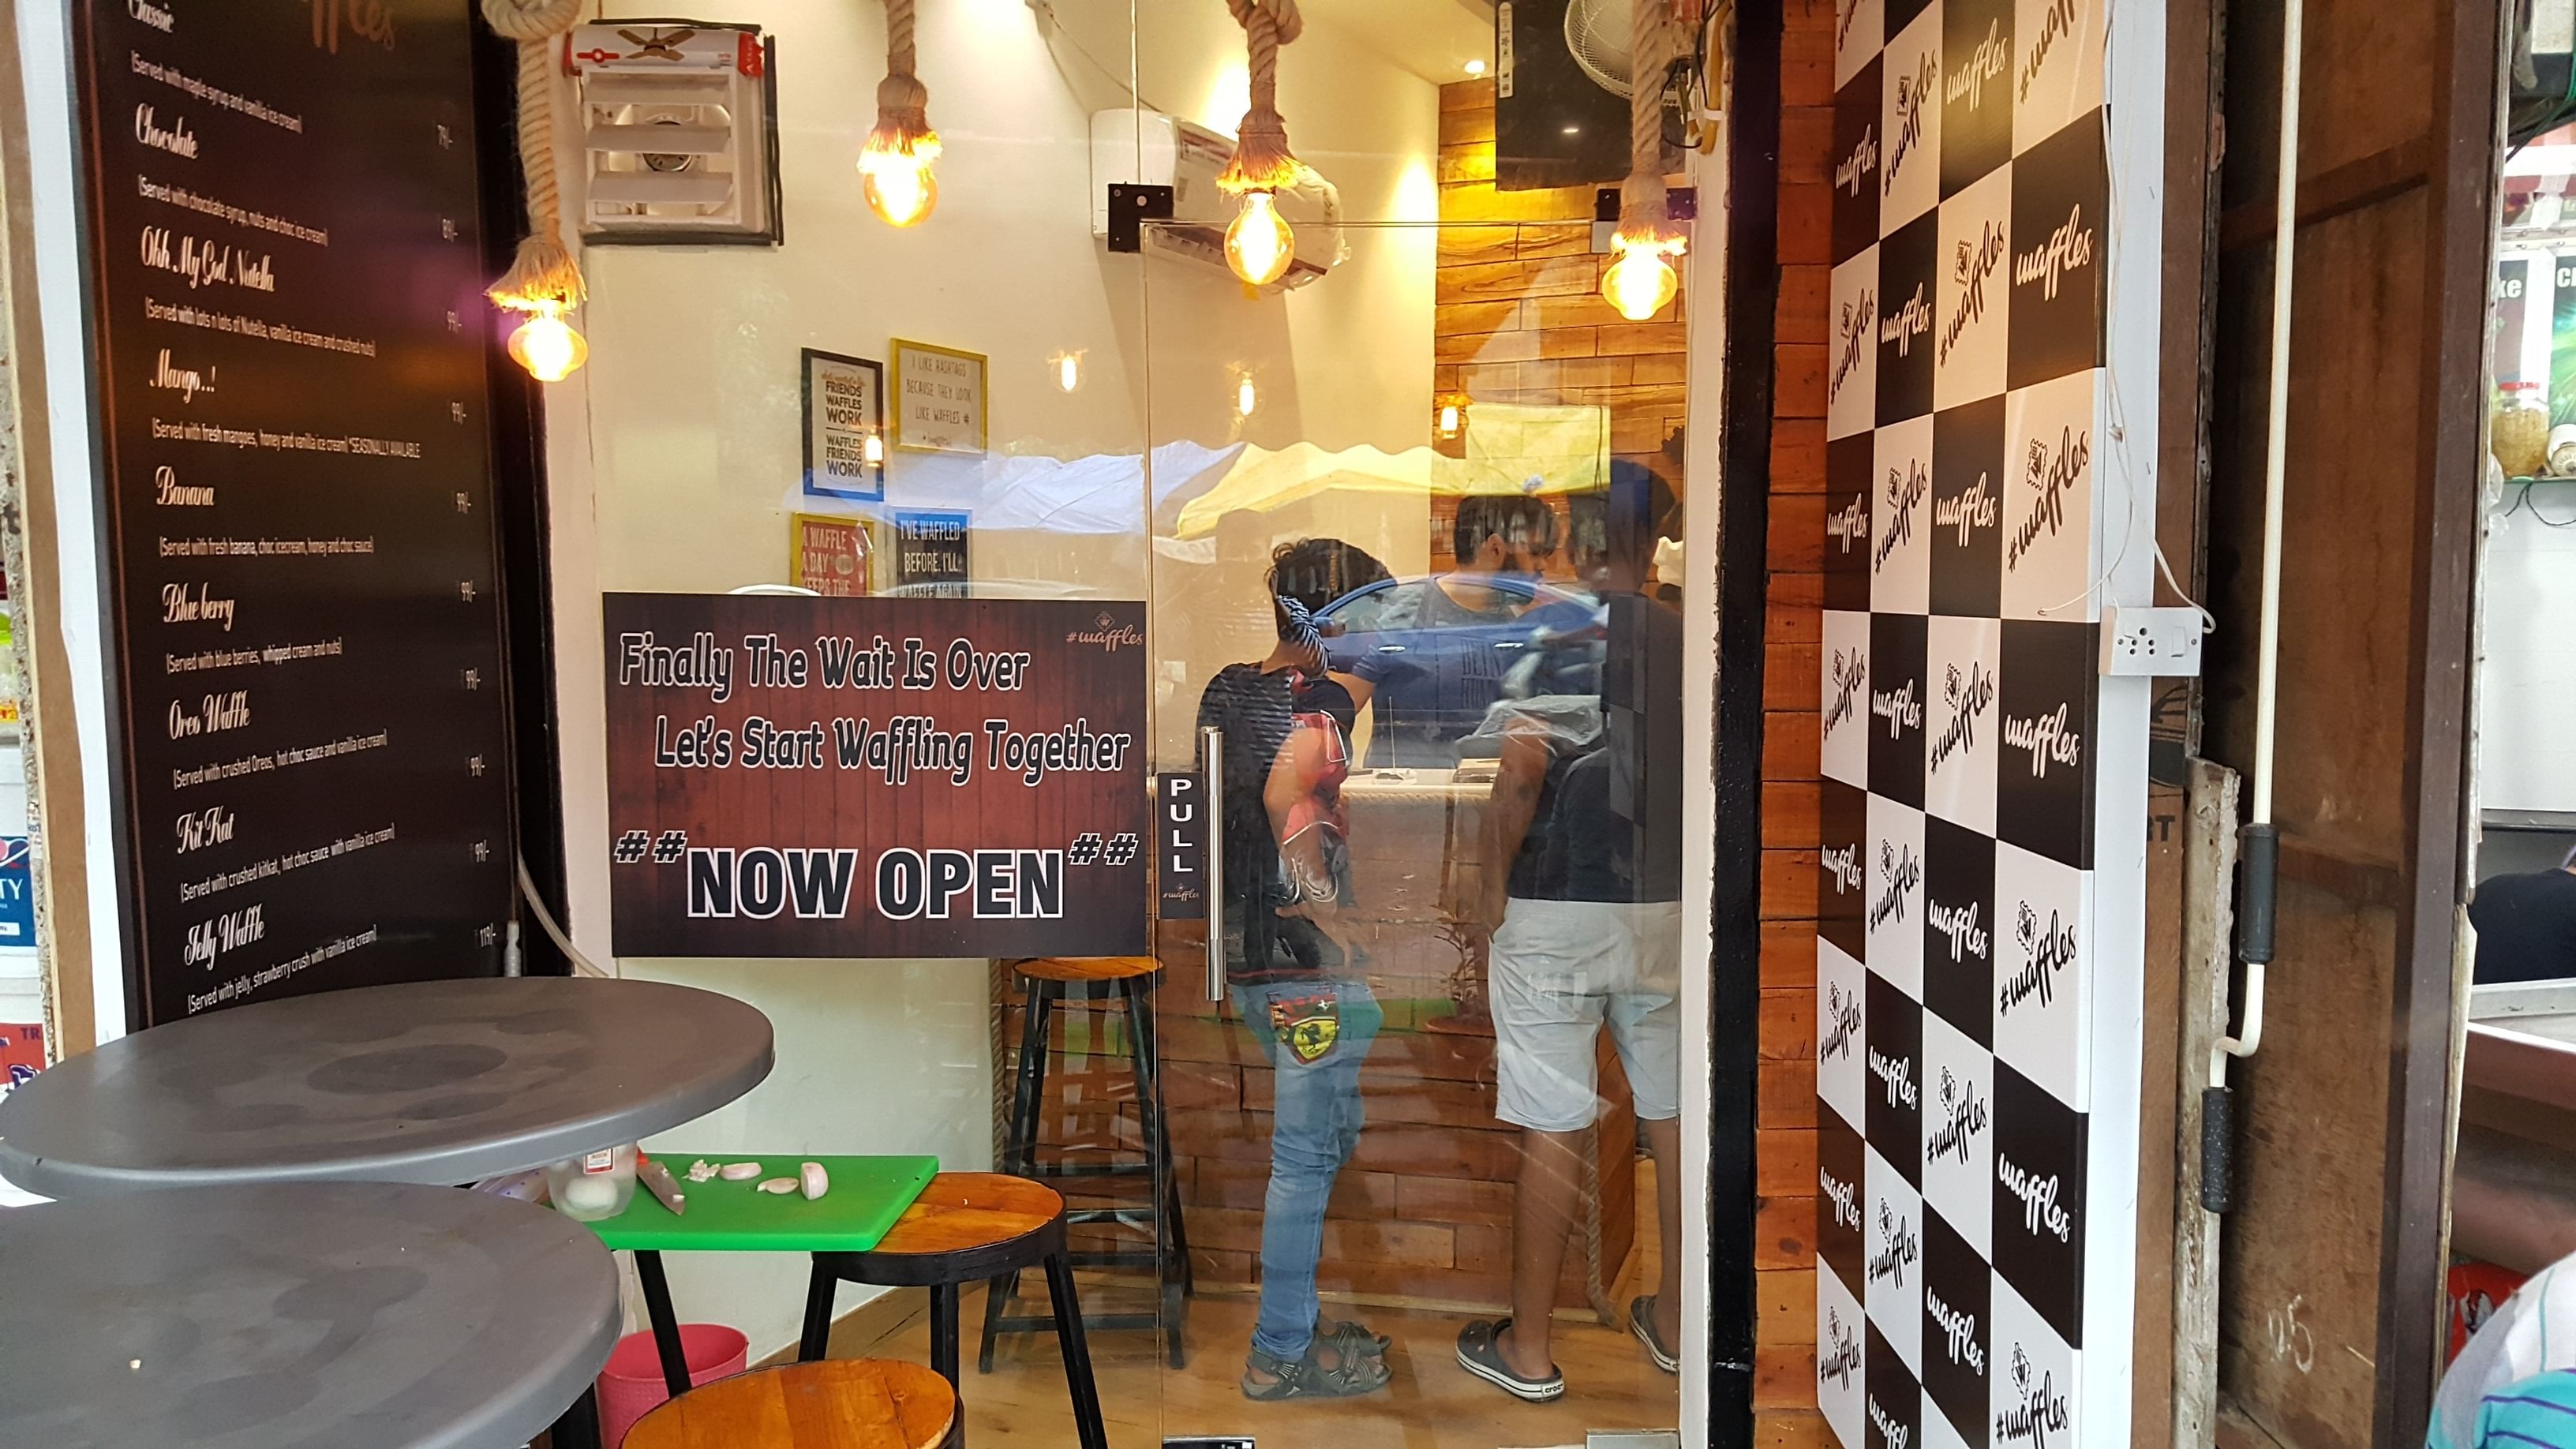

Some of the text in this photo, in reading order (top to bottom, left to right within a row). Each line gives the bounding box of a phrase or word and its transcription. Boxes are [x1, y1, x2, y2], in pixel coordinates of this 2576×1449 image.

[1947, 17, 2007, 111] waffles
[136, 103, 199, 159] Chocolate
[1885, 49, 1938, 197] #waffles
[1836, 124, 1877, 197] waffles
[141, 225, 170, 269] Ohh
[202, 240, 230, 285] God
[2016, 204, 2092, 301] waffles
[1881, 282, 1930, 358] waffles
[1940, 220, 2005, 368] #waffles
[918, 357, 933, 372] LIKE
[1829, 287, 1874, 406] #waffles
[826, 380, 862, 398] FRIENDS
[826, 393, 862, 410] WAFFLES
[826, 406, 862, 427] WORK
[906, 378, 972, 403] BECAUSE THEY LOOK
[915, 405, 930, 421] LIKE
[933, 408, 960, 425] WAFFLES
[826, 433, 862, 450] WAFFLES
[826, 446, 862, 462] FRIENDS
[826, 459, 863, 479] WORK
[155, 465, 215, 507] Banana
[1875, 458, 1926, 575] #waffles
[1937, 471, 1996, 547] waffles
[2009, 425, 2088, 572] #waffles
[803, 526, 847, 550] A WAFFLE
[900, 519, 960, 541] I'VE WAFFLED
[1828, 492, 1868, 553] waffles
[803, 552, 829, 574] A DAY
[833, 578, 850, 597] THE
[163, 582, 234, 631] Blue berry
[1066, 624, 1144, 652] #waffles
[620, 632, 1031, 704] Finally The Wait Is Over
[1823, 646, 1866, 740] #waffles
[169, 690, 252, 739] Oreo Waffle
[1873, 678, 1921, 740] waffles
[1931, 661, 1993, 775] #waffles
[2005, 702, 2080, 779] waffles
[204, 762, 220, 781] with
[221, 756, 250, 778] crushed
[276, 750, 288, 766] hot
[289, 747, 304, 765] choc
[305, 746, 324, 762] sauce
[324, 739, 335, 757] and
[336, 735, 357, 754] vanilla
[357, 735, 365, 750] ice
[655, 715, 1132, 787] Let's Start Waffling Together
[176, 805, 234, 854] Kit Kat
[475, 839, 489, 863] 99/-
[1170, 779, 1193, 872] PULL
[211, 872, 227, 893] with
[228, 863, 256, 887] crushed
[282, 854, 293, 871] hot
[294, 851, 309, 867] choc
[309, 846, 328, 863] sauce
[330, 838, 344, 856] with
[344, 833, 364, 852] vanilla
[365, 830, 373, 846] ice
[1822, 843, 1861, 895] waffles
[1870, 844, 1919, 934] #waffles
[184, 903, 266, 971] Jelly Waffle
[1929, 899, 1988, 963] waffles
[2000, 909, 2076, 1017] #waffles
[218, 980, 234, 1002] with
[253, 962, 290, 988] strawberry
[291, 951, 310, 972] crush
[310, 946, 324, 964] with
[324, 938, 345, 958] vanilla
[346, 935, 354, 951] ice
[1820, 990, 1861, 1065] #waffles
[1869, 1045, 1917, 1110] waffles
[1926, 1080, 1987, 1166] #waffles
[1820, 1166, 1860, 1232] waffles
[1999, 1152, 2070, 1243] waffles
[1869, 1215, 1917, 1289] #waffles
[1820, 1326, 1861, 1391] #waffles
[1926, 1286, 1984, 1376] waffles
[1869, 1392, 1908, 1449] waffl
[1997, 1372, 2068, 1449] #waffles
